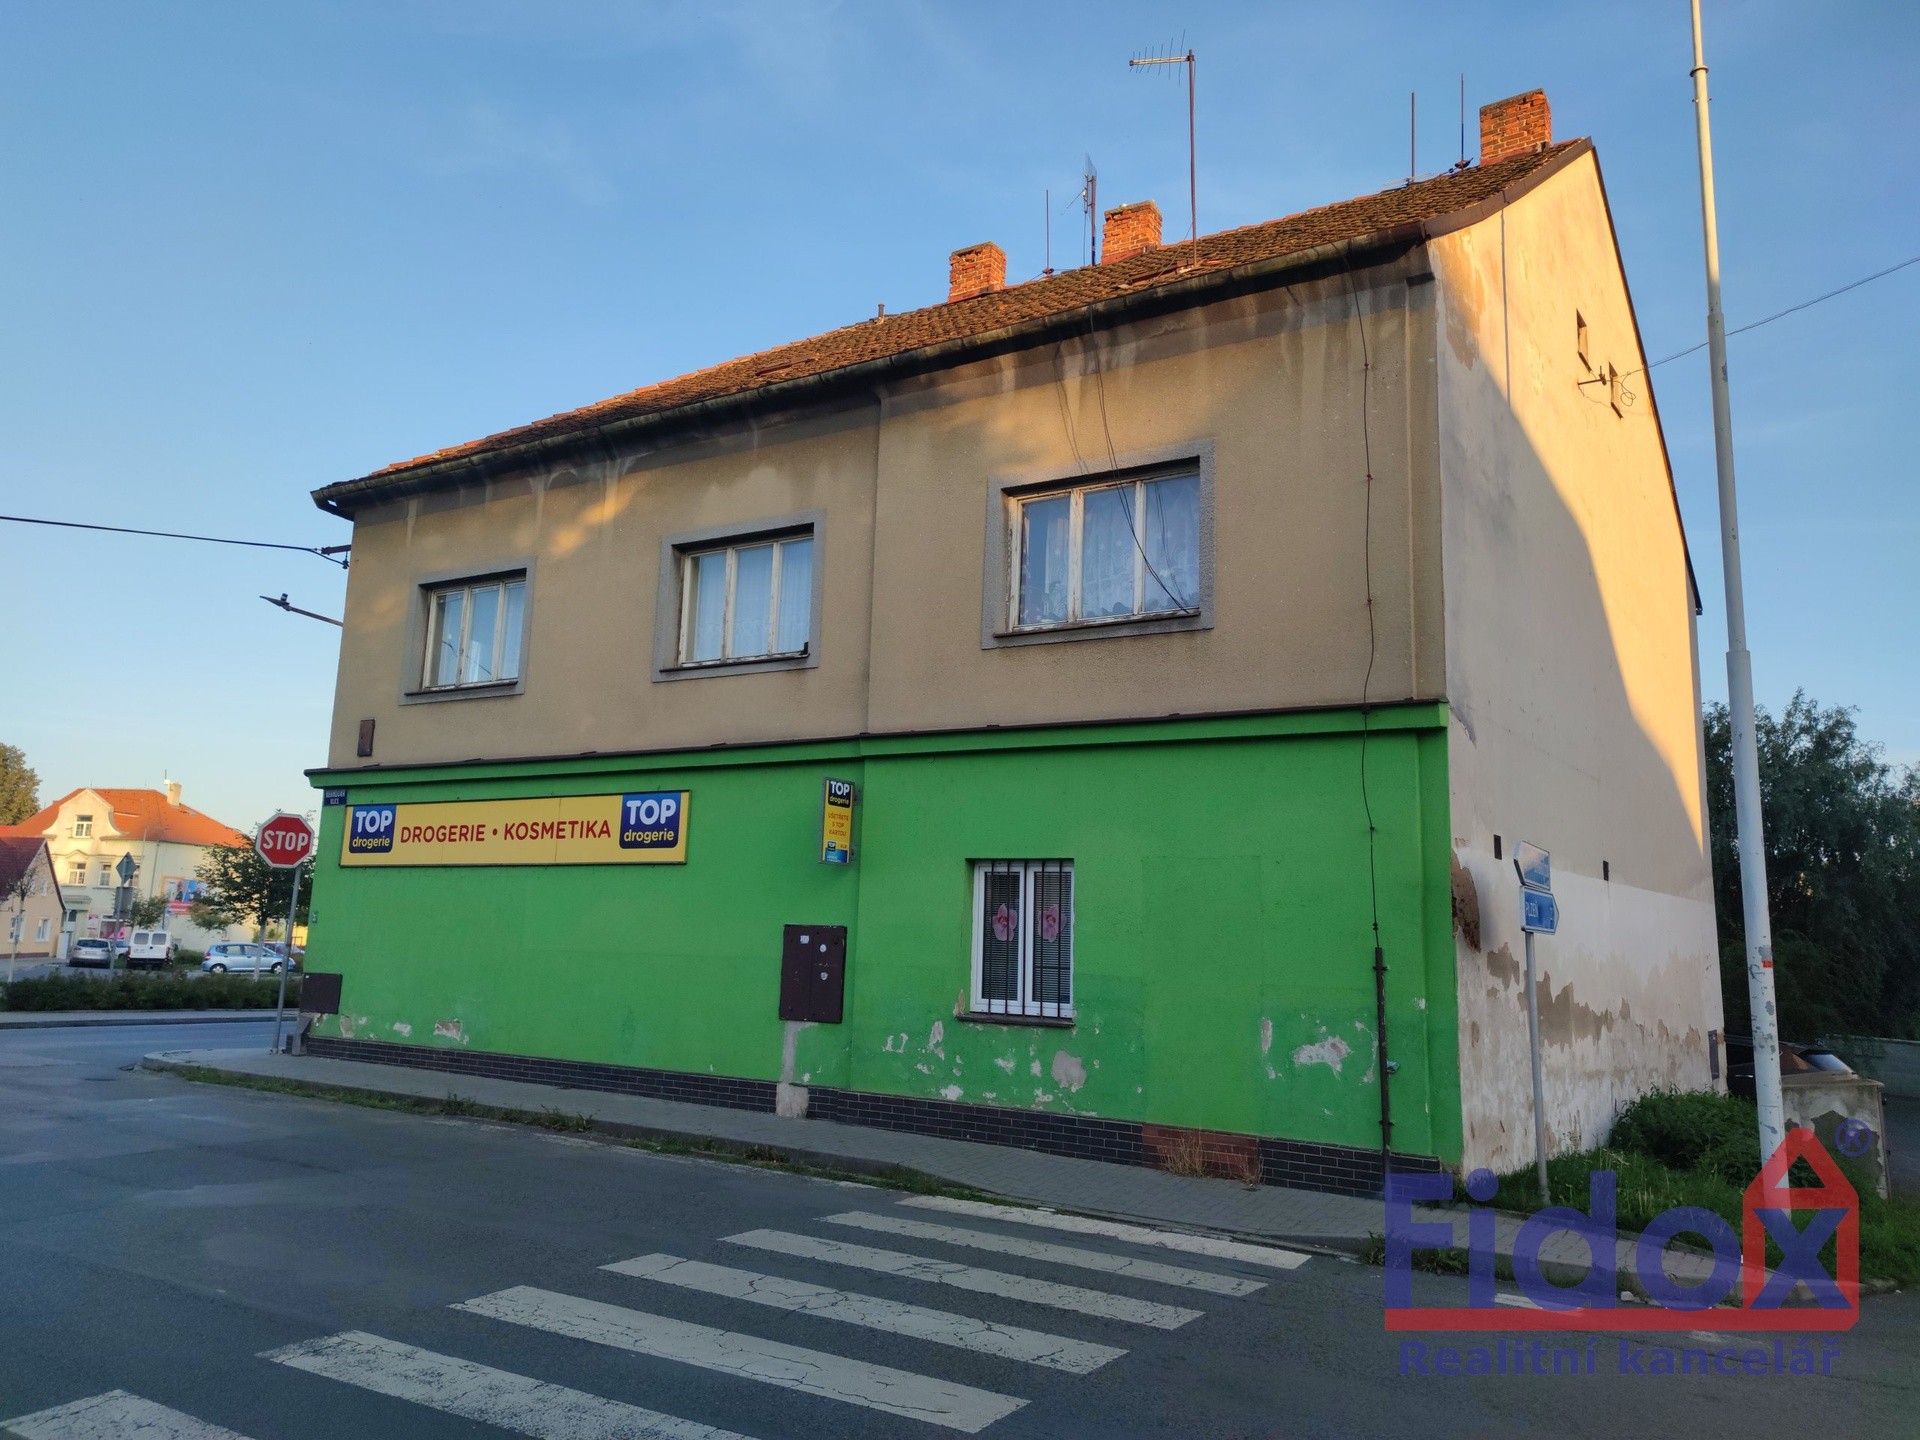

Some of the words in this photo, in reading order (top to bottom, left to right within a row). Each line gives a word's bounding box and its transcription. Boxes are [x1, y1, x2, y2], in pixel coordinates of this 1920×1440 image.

[830, 780, 850, 796] TOP
[829, 795, 850, 805] drogerie
[626, 798, 677, 826] TOP
[355, 810, 393, 834] TOP
[400, 824, 486, 844] DROGERIE
[503, 819, 612, 841] KOSMETIKA
[262, 829, 309, 852] STOP
[352, 835, 391, 850] drogerie
[624, 828, 675, 844] drogerie
